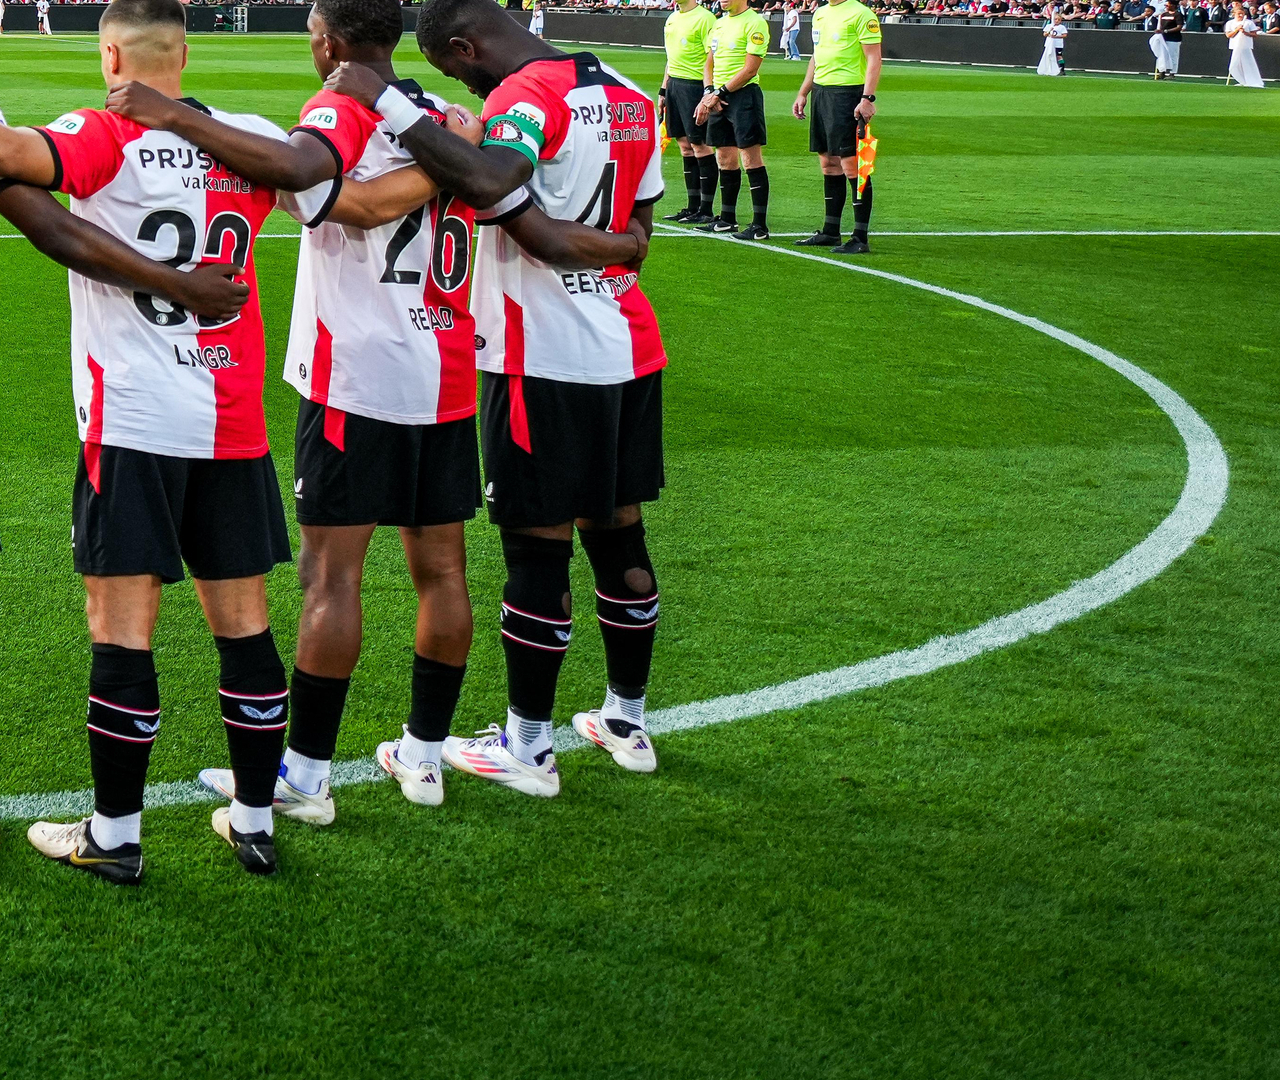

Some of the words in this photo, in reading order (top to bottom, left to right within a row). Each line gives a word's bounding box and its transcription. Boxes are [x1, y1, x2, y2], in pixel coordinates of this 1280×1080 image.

[301, 113, 333, 125] TOTO
[379, 191, 470, 294] 26
[575, 160, 618, 273] 4
[407, 306, 455, 331] READ
